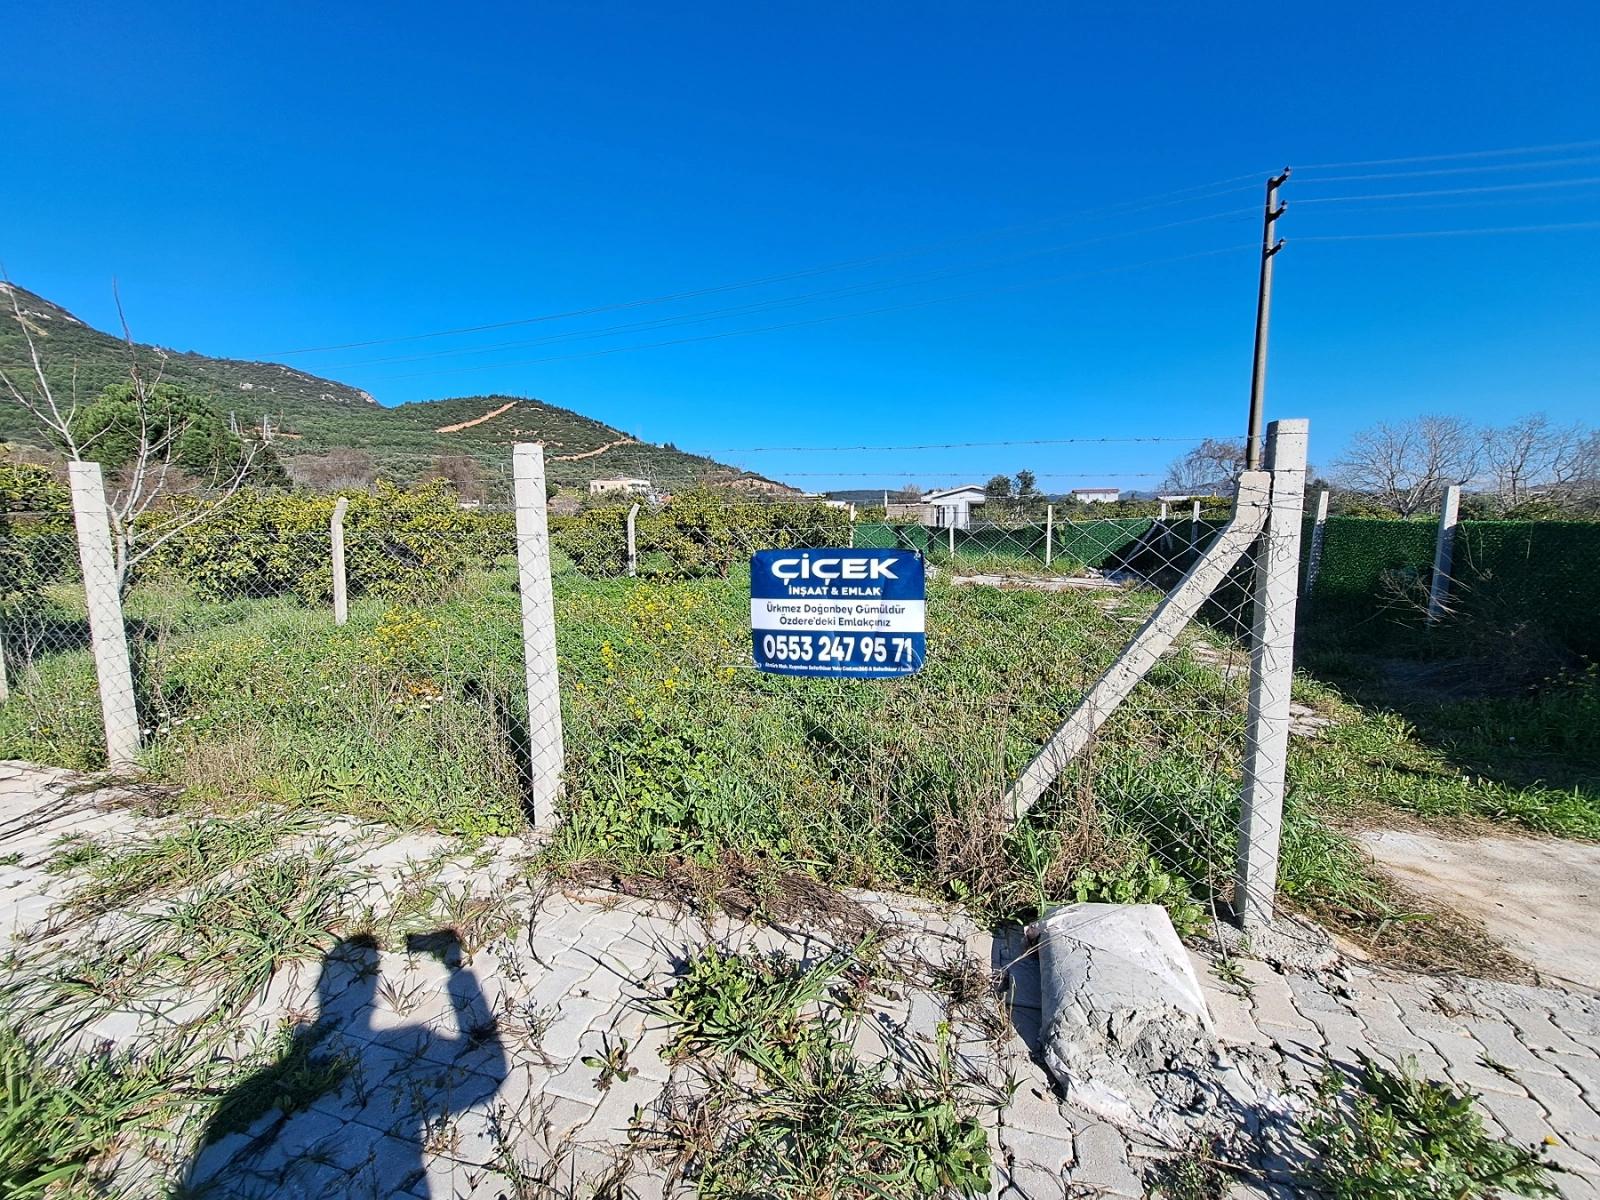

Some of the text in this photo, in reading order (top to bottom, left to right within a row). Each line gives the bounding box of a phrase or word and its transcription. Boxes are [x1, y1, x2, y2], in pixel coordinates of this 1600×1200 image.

[771, 553, 899, 586] ÇİÇEK
[788, 585, 882, 597] İNŞAAT & EMLAK
[766, 602, 906, 616] Ürkmez Doğanbey Gümüldür
[779, 614, 891, 629] Özdere'deki Emlakçınız
[763, 634, 913, 663] 0553 247 95 71
